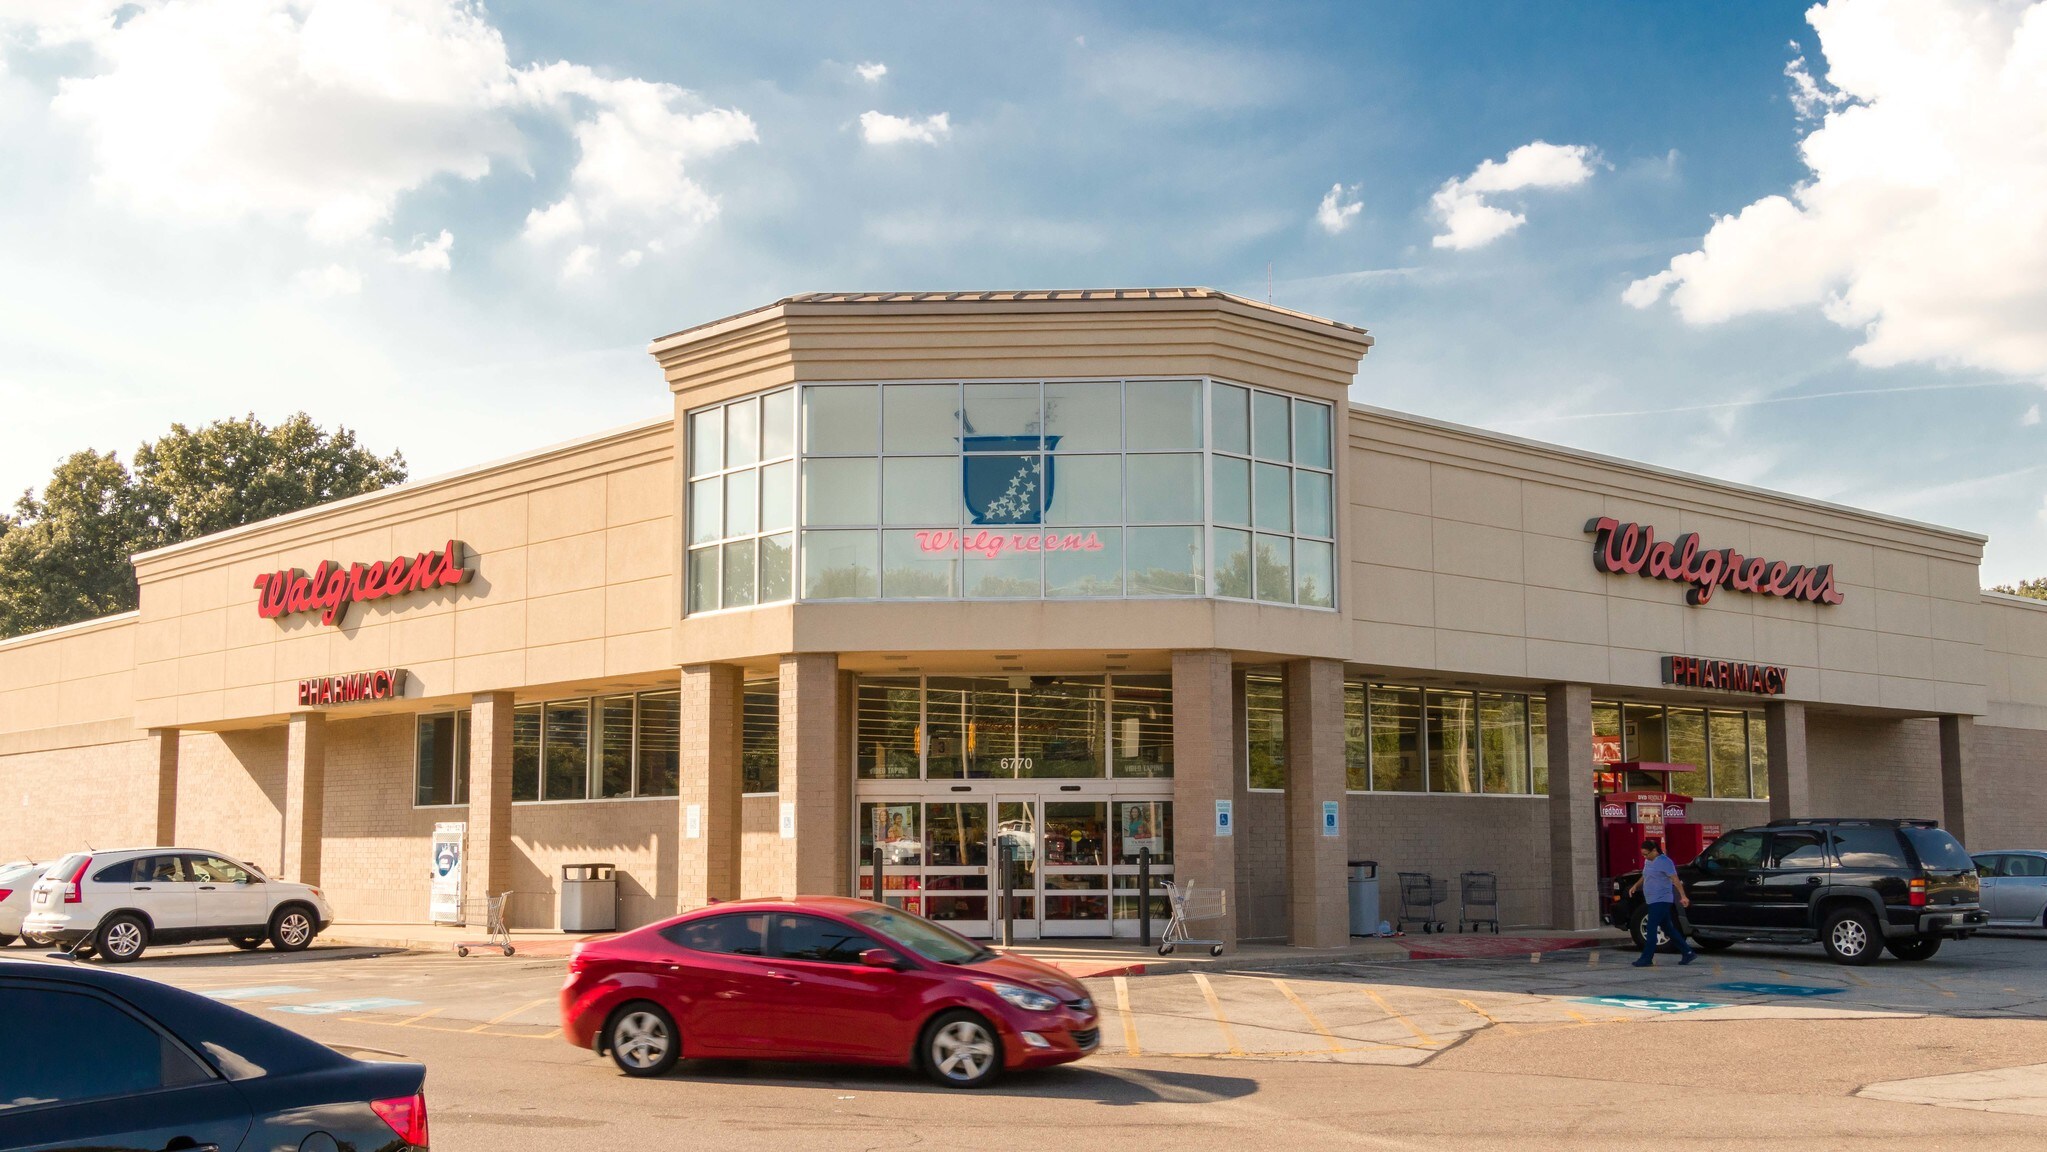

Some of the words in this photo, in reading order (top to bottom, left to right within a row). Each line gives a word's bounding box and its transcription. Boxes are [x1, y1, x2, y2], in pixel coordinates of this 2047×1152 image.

[914, 529, 1104, 559] Walgreens
[1594, 516, 1845, 606] Walgreens
[253, 539, 465, 627] Walgreens
[298, 668, 399, 706] PHARMACY
[1672, 655, 1788, 695] PHARMACY
[1000, 757, 1033, 770] 6770
[1602, 806, 1624, 816] redbox
[1664, 806, 1684, 817] redbox
